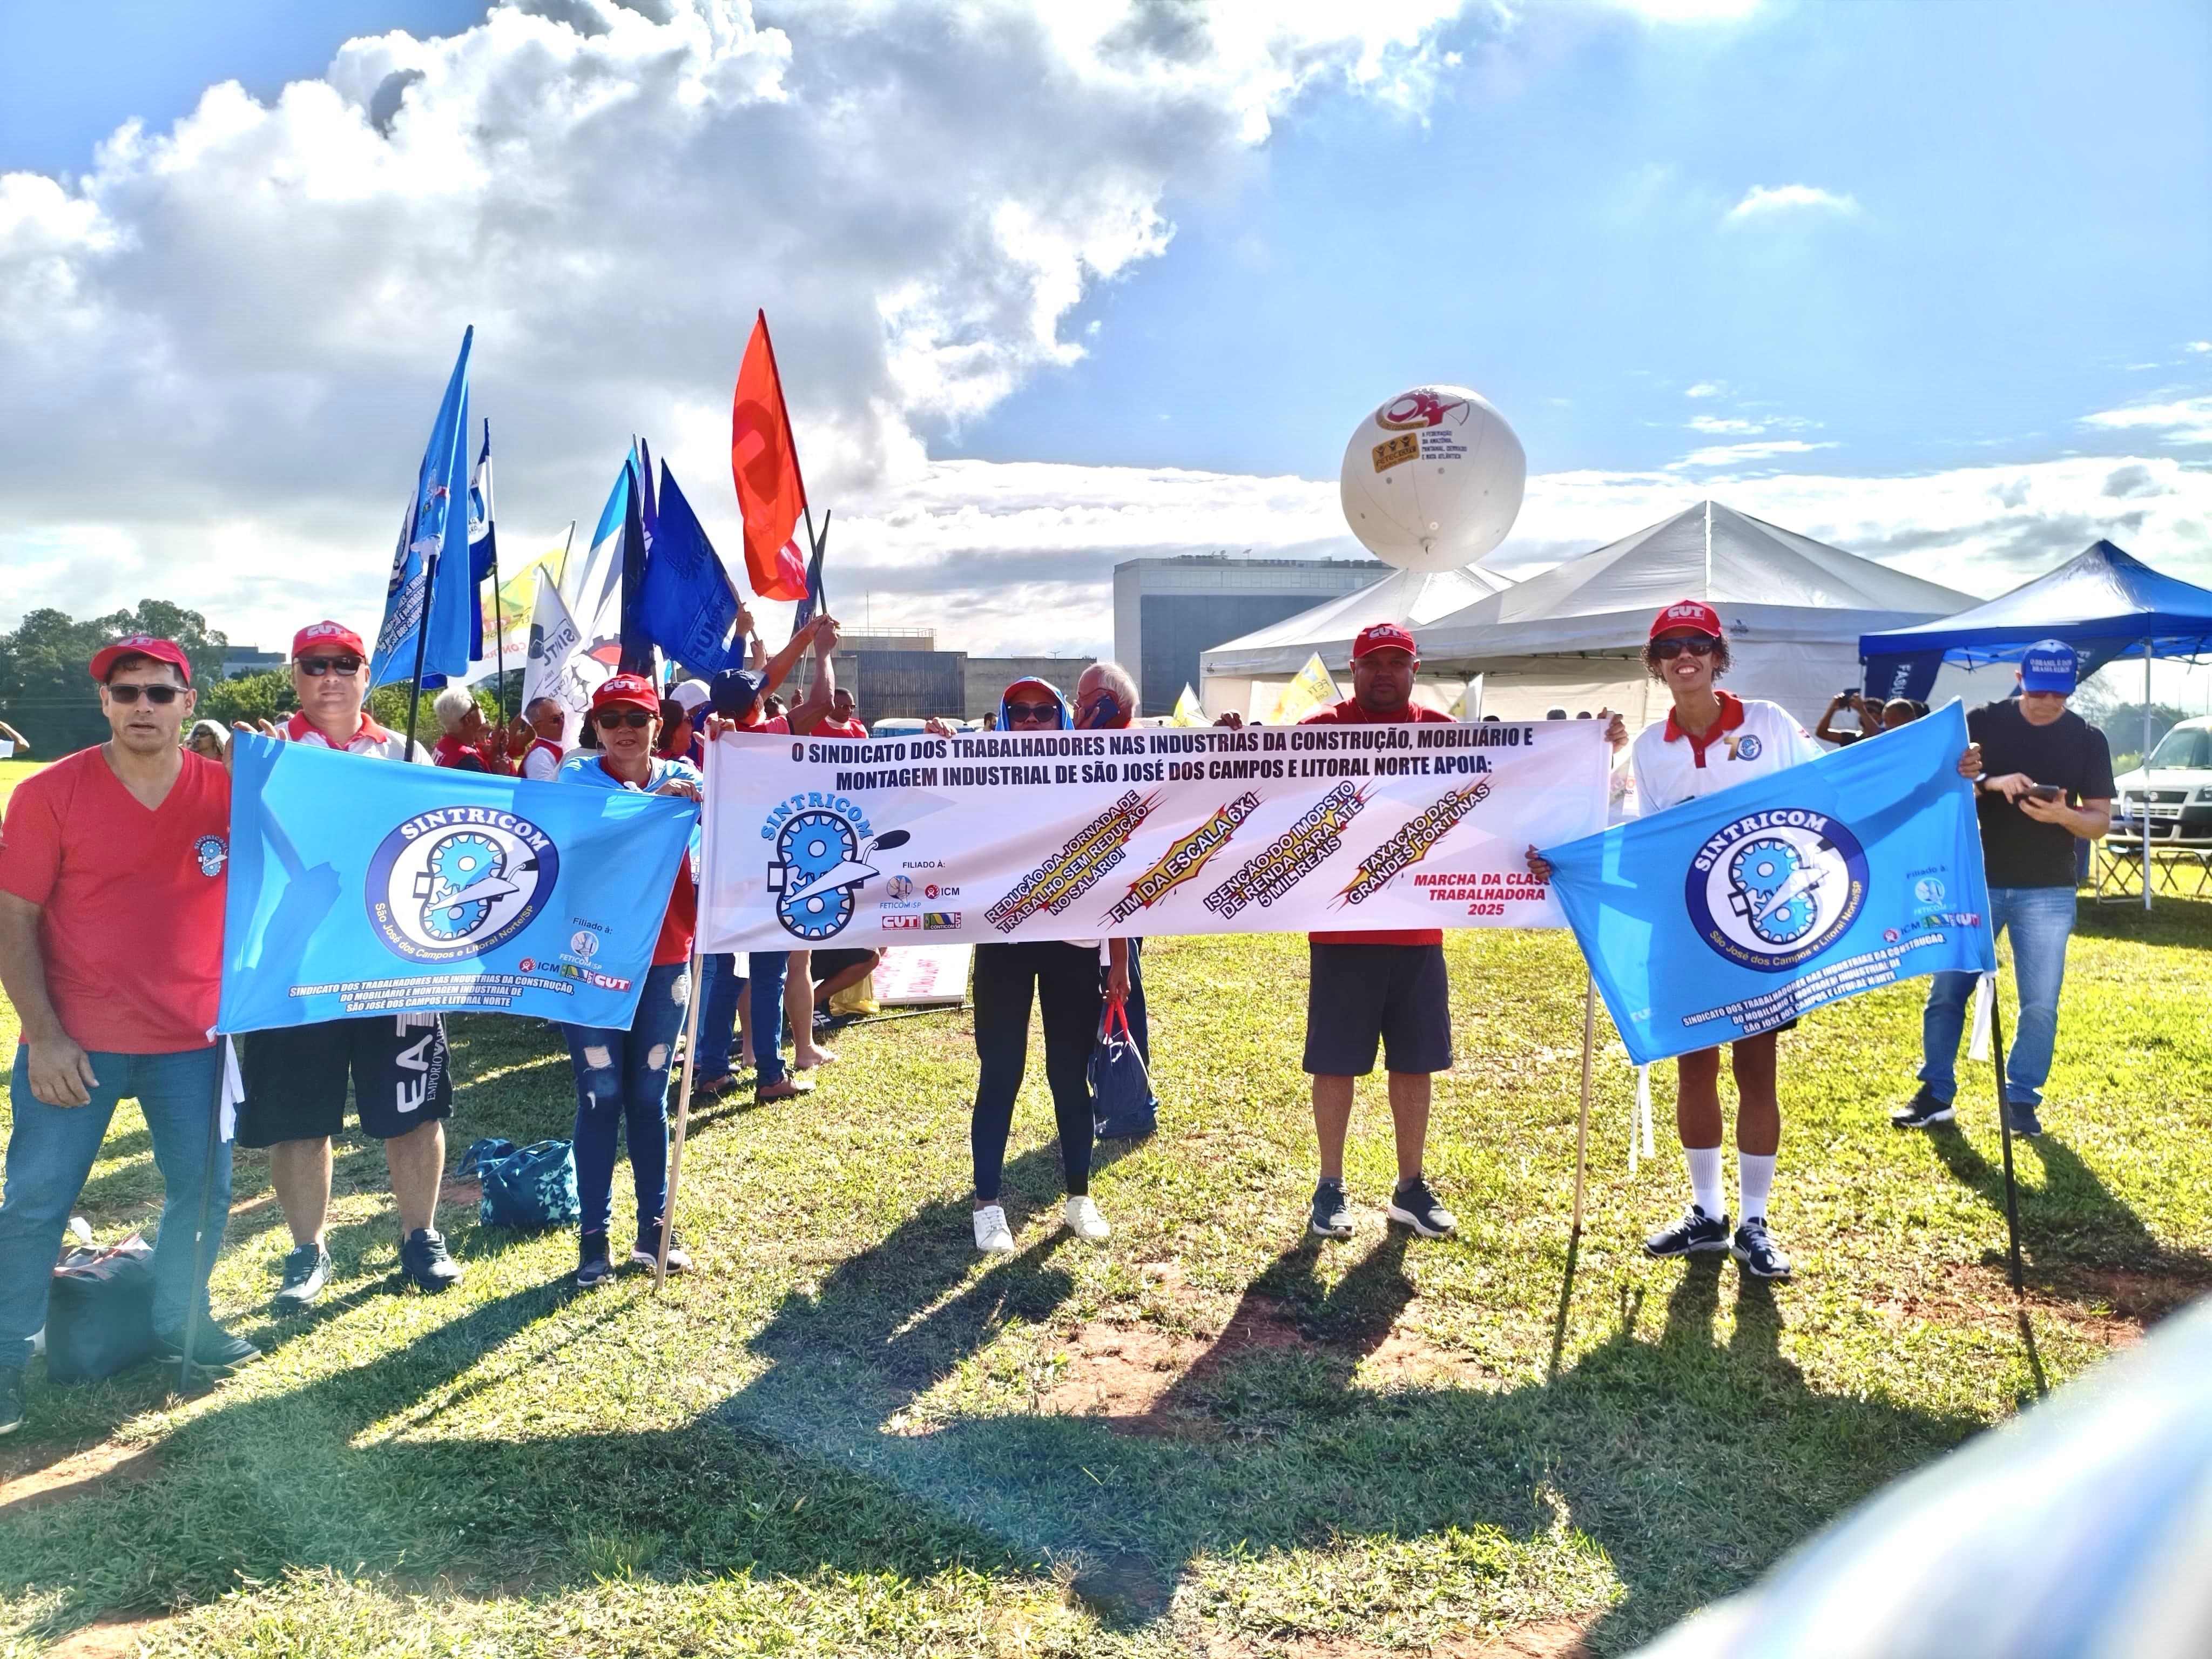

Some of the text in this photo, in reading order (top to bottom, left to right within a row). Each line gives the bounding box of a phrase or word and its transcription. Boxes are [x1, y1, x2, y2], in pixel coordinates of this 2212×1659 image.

[1668, 605, 1703, 618] CUT
[307, 625, 341, 636] CUT
[1370, 627, 1399, 638] CUT
[604, 680, 637, 691] CUT
[792, 725, 1533, 764] O SINDICATO DOS TRABALHADORES NAS INDUSTRIAS DA CONSTRUÇÃO, MOBILIÁRIO E
[837, 756, 1492, 791] MONTAGEM INDUSTRIAL DE SÃO JOSÉ DOS CAMPOS E LITORAL NORTE APOIA:
[401, 808, 550, 852] SINTRICOM
[761, 792, 874, 841] SINTRICOM
[1359, 791, 1458, 874] TAXAÇÃO DAS
[984, 790, 1140, 923] REDUÇÃO DA JORNADA DE
[1110, 792, 1259, 922] FIM DA ESCALA 6X1
[1203, 781, 1355, 912] ISENÇÃO DO IMOPSTO
[1220, 796, 1364, 919] DE RENDA PARA ATÉ
[1348, 784, 1490, 905] GRANDES FORTUNAS
[1695, 811, 1827, 872] SINTRICOM
[938, 860, 946, 868] À:
[997, 805, 1148, 933] TRABALHO SEM REDUÇÃO
[1048, 846, 1126, 915] NO SALÁRIO!
[1258, 837, 1341, 907] 5 MIL REAIS
[1414, 874, 1500, 886] MARCHA DA
[1906, 867, 1937, 879] Filiado
[941, 887, 960, 896] ICM
[1430, 889, 1545, 900] TRABALHADORA
[572, 918, 612, 935] Filiado à:
[883, 916, 915, 927] CUT
[1468, 904, 1505, 915] 2025
[375, 902, 387, 922] São
[383, 923, 402, 945] José
[398, 942, 415, 955] dos
[416, 948, 454, 960] Campos
[466, 935, 497, 955] Litoral
[499, 905, 534, 939] Norte/SP
[1901, 921, 1921, 935] ICM
[1710, 930, 1725, 948] São
[1726, 946, 1748, 960] José
[1751, 955, 1770, 966] dos
[1773, 948, 1811, 966] Campos
[537, 961, 559, 973] ICM
[595, 974, 629, 990] CUT
[289, 975, 574, 997] SINDICATO DOS TRABALHADORES NAS INDUSTRIAS DA CONSTRUÇÃO,
[340, 986, 523, 1002] DO MOBILIÁRIO E MONTAGEM INDUSTRIAL DE
[346, 995, 511, 1012] SÃO JOSÉ DOS CAMPOS E LITORAL NORTE
[1683, 1007, 1725, 1026] SINDICATO
[1725, 1003, 1743, 1016] DOS
[1743, 979, 1806, 1010] TRABALHADORES
[1806, 970, 1823, 983] NAS
[1822, 952, 1873, 976] INDUSTRIAS
[1873, 949, 1887, 960] DA
[1732, 1014, 1744, 1025] DO
[1745, 999, 1789, 1021] MOBILIÁRIO
[1795, 975, 1838, 1000] MONTAGEM
[1838, 962, 1889, 982] INDUSTRIAL
[1743, 1022, 1761, 1034] SÃO
[1763, 1015, 1781, 1029] JOSÉ
[1781, 1007, 1795, 1020] DOS
[1795, 992, 1828, 1012] CAMPOS
[1827, 990, 1833, 998] E
[1833, 977, 1867, 995] LITORAL
[427, 1056, 443, 1102] EMPORIO
